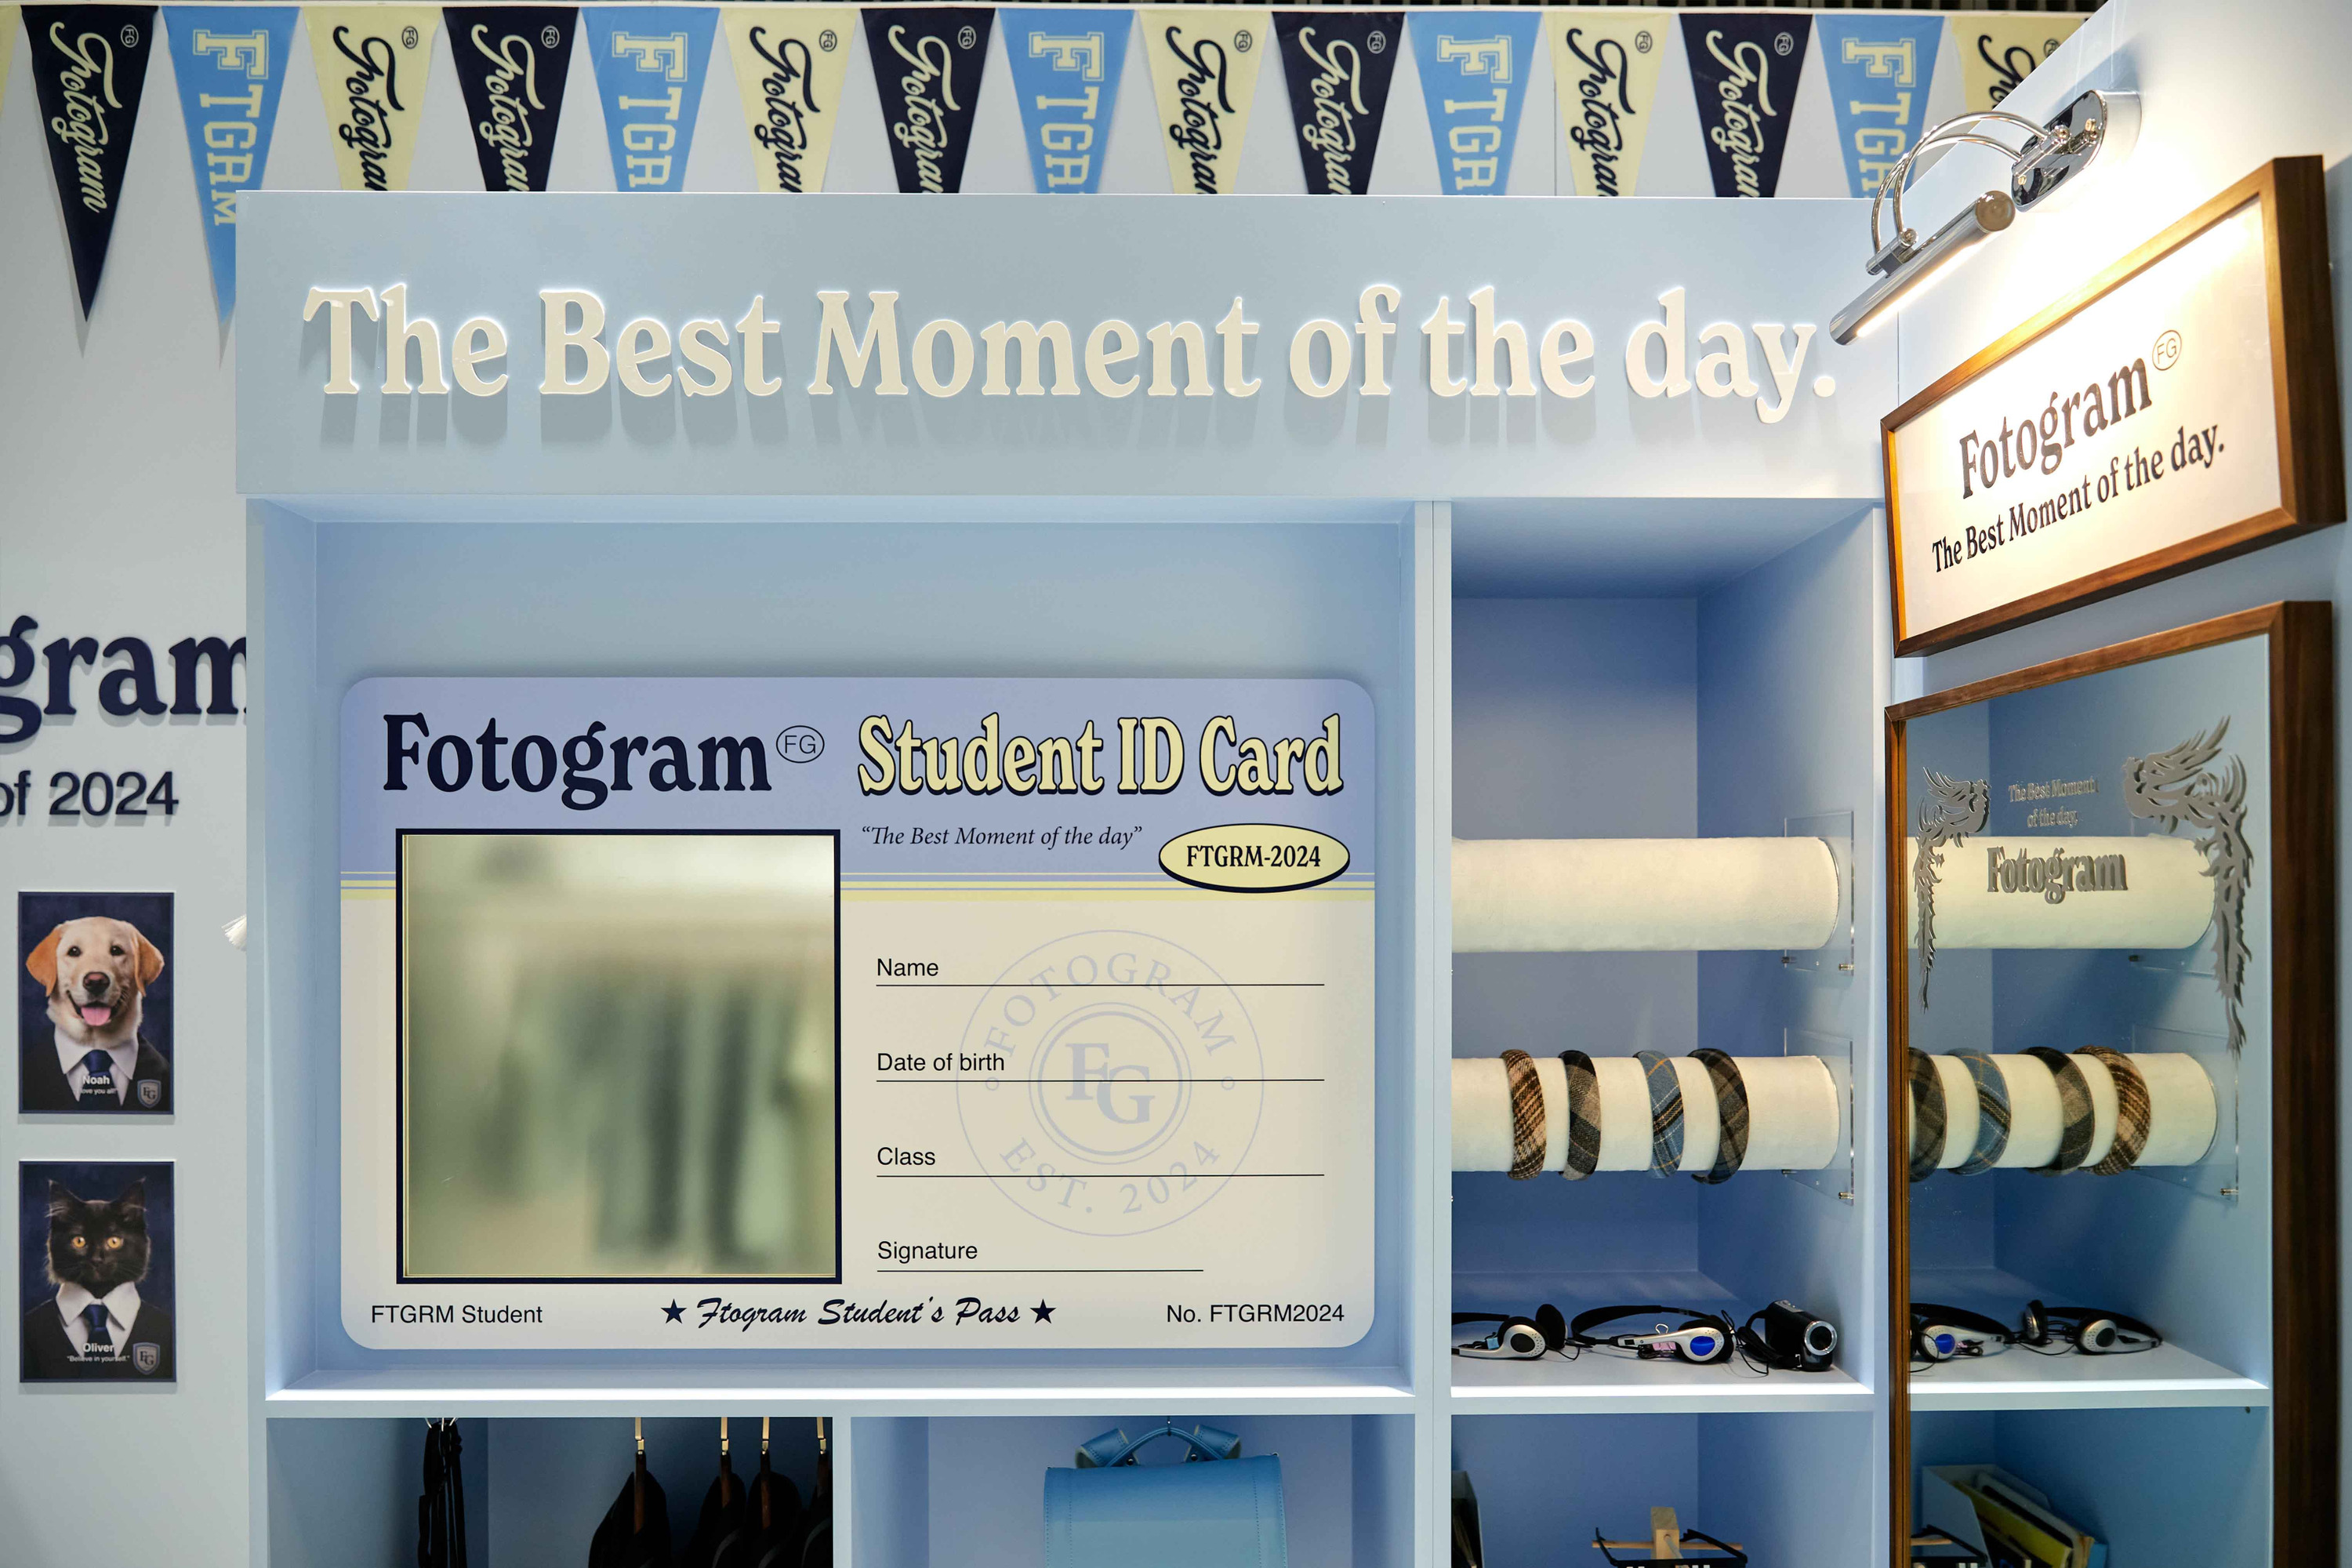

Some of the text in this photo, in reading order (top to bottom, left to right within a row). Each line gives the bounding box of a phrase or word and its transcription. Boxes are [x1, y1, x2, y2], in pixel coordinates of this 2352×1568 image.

[50, 22, 122, 213] Fotogram
[333, 26, 403, 191] Fotogra
[472, 24, 544, 191] Fotogra
[612, 32, 688, 189] FTGR
[750, 27, 819, 193] Fotogra
[887, 25, 960, 193] Fotogra
[1029, 32, 1104, 194] FTGR
[1166, 27, 1235, 194] Fotogra
[1299, 27, 1368, 194] Fotogra
[1437, 35, 1512, 194] FTGR
[1568, 29, 1634, 196] Fotogra
[1705, 30, 1776, 197] Fotogra
[303, 284, 1836, 424] The Best Moment of the day.
[1959, 357, 2153, 499] Fotogram
[1933, 424, 2225, 572] The Best Moment of the day.
[49, 771, 179, 816] 2024
[383, 712, 773, 811] Fotogram
[858, 711, 1345, 797] Student ID Card
[910, 827, 950, 845] Best
[954, 827, 1036, 845] Moment
[1040, 826, 1062, 851] of
[1065, 826, 1093, 844] the
[1186, 844, 1321, 868] FTGRM-2024
[1987, 847, 2129, 904] Fotogram
[877, 958, 939, 977] Name
[984, 953, 1237, 1058] FOTOGRAM
[83, 1075, 110, 1084] Noah
[877, 1052, 1005, 1072] Date of birth
[877, 1146, 936, 1166] Class
[1120, 1141, 1221, 1214] 2024
[877, 1240, 978, 1265] Signature
[82, 1342, 114, 1353] Oliver
[372, 1305, 543, 1323] FTGRM Student
[955, 1297, 1021, 1327] Pass
[1167, 1304, 1345, 1323] No. FTGRM2024
